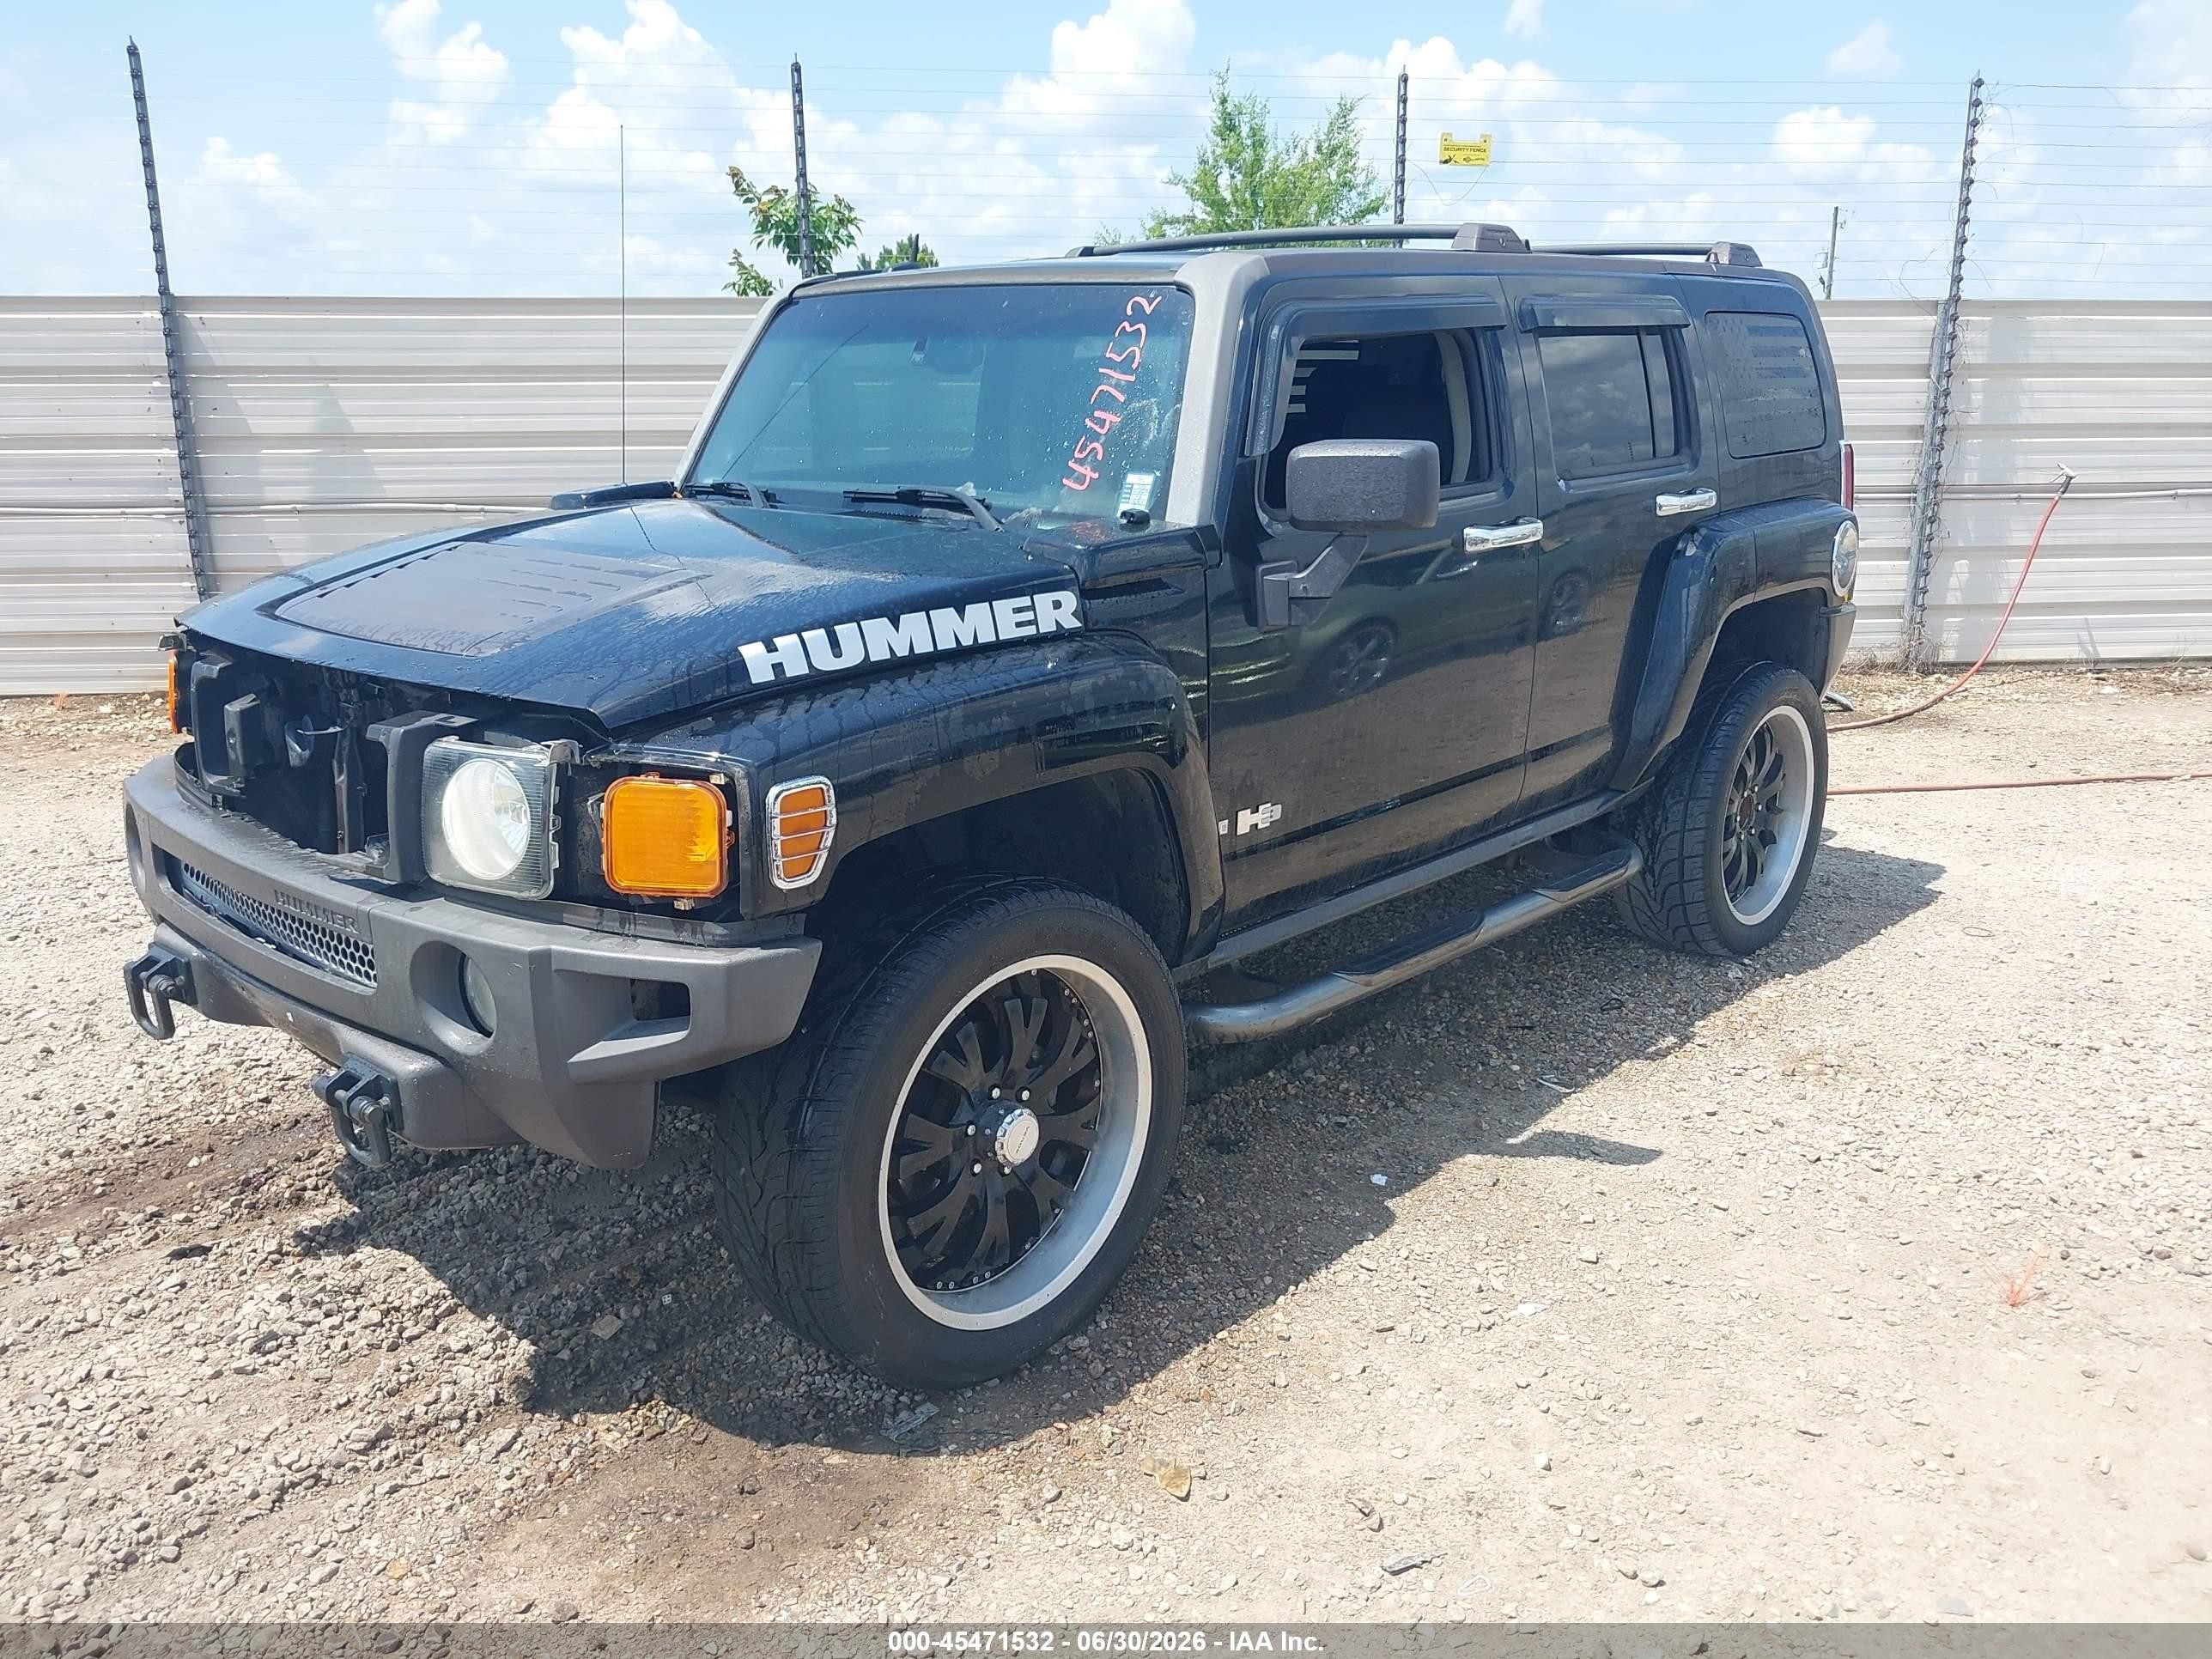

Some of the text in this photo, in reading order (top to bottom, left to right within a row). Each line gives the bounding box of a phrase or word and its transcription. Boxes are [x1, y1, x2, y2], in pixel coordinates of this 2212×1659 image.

[1062, 295, 1163, 491] 45471532
[738, 590, 1083, 684] HUMMER
[1237, 802, 1282, 836] H3
[274, 889, 360, 934] HUMMER
